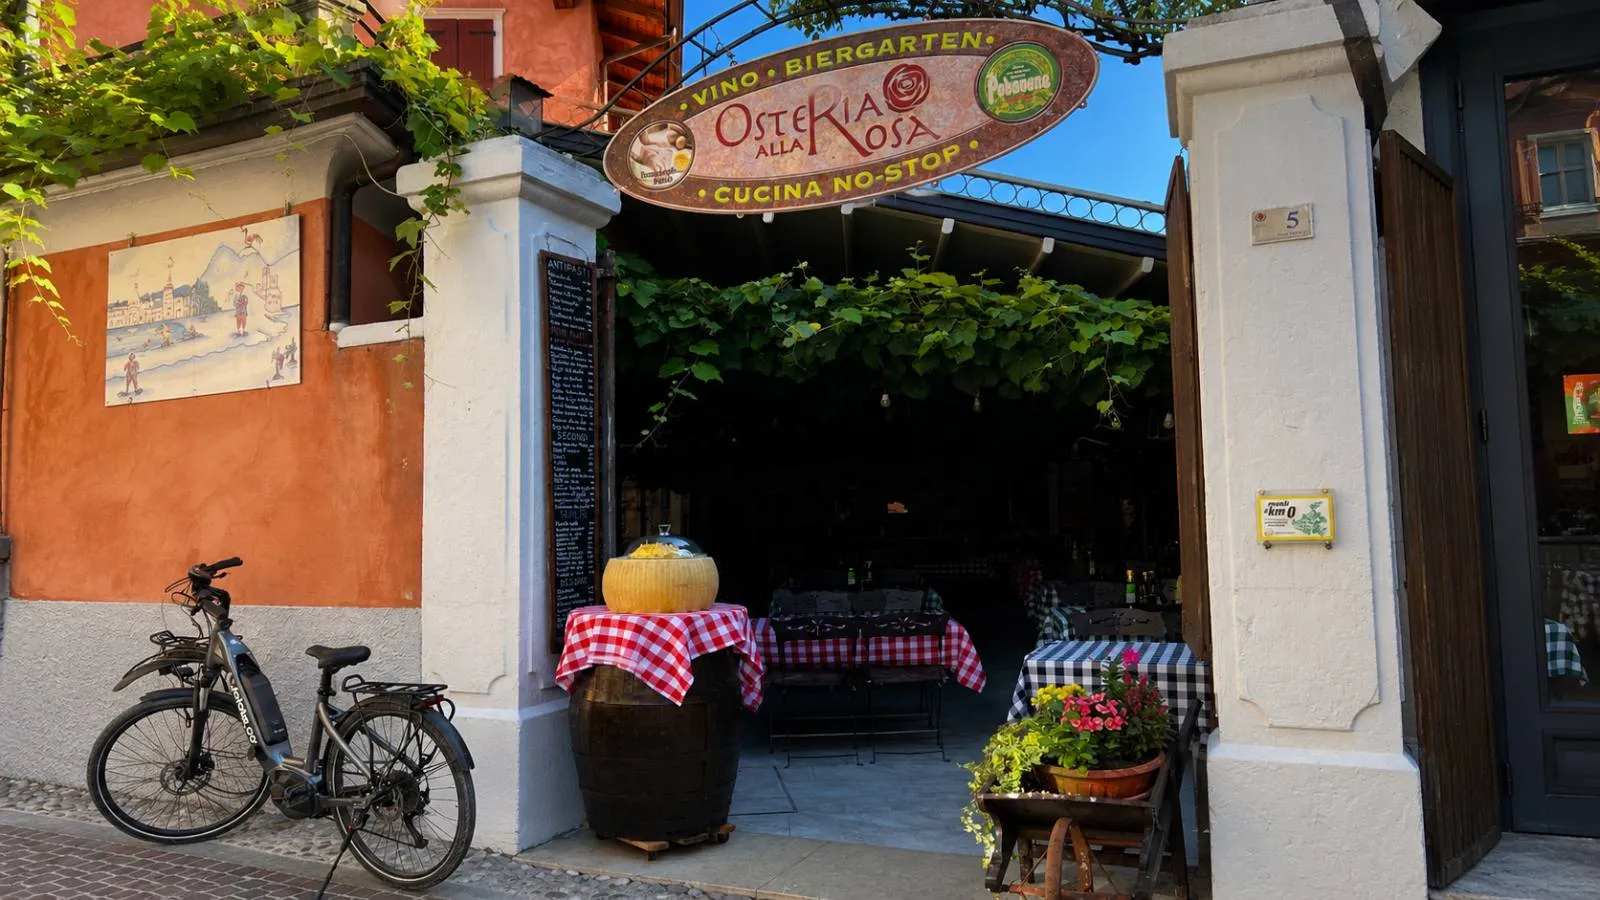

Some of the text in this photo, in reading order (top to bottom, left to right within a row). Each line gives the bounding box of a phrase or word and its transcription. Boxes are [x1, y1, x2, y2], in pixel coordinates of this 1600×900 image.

[692, 31, 982, 106] VINO BIERGARTEN
[755, 138, 804, 159] ALLA
[714, 144, 961, 204] CUCINA NO-STOP
[1286, 210, 1300, 229] 5
[1268, 506, 1286, 516] km
[1287, 506, 1296, 518] 0
